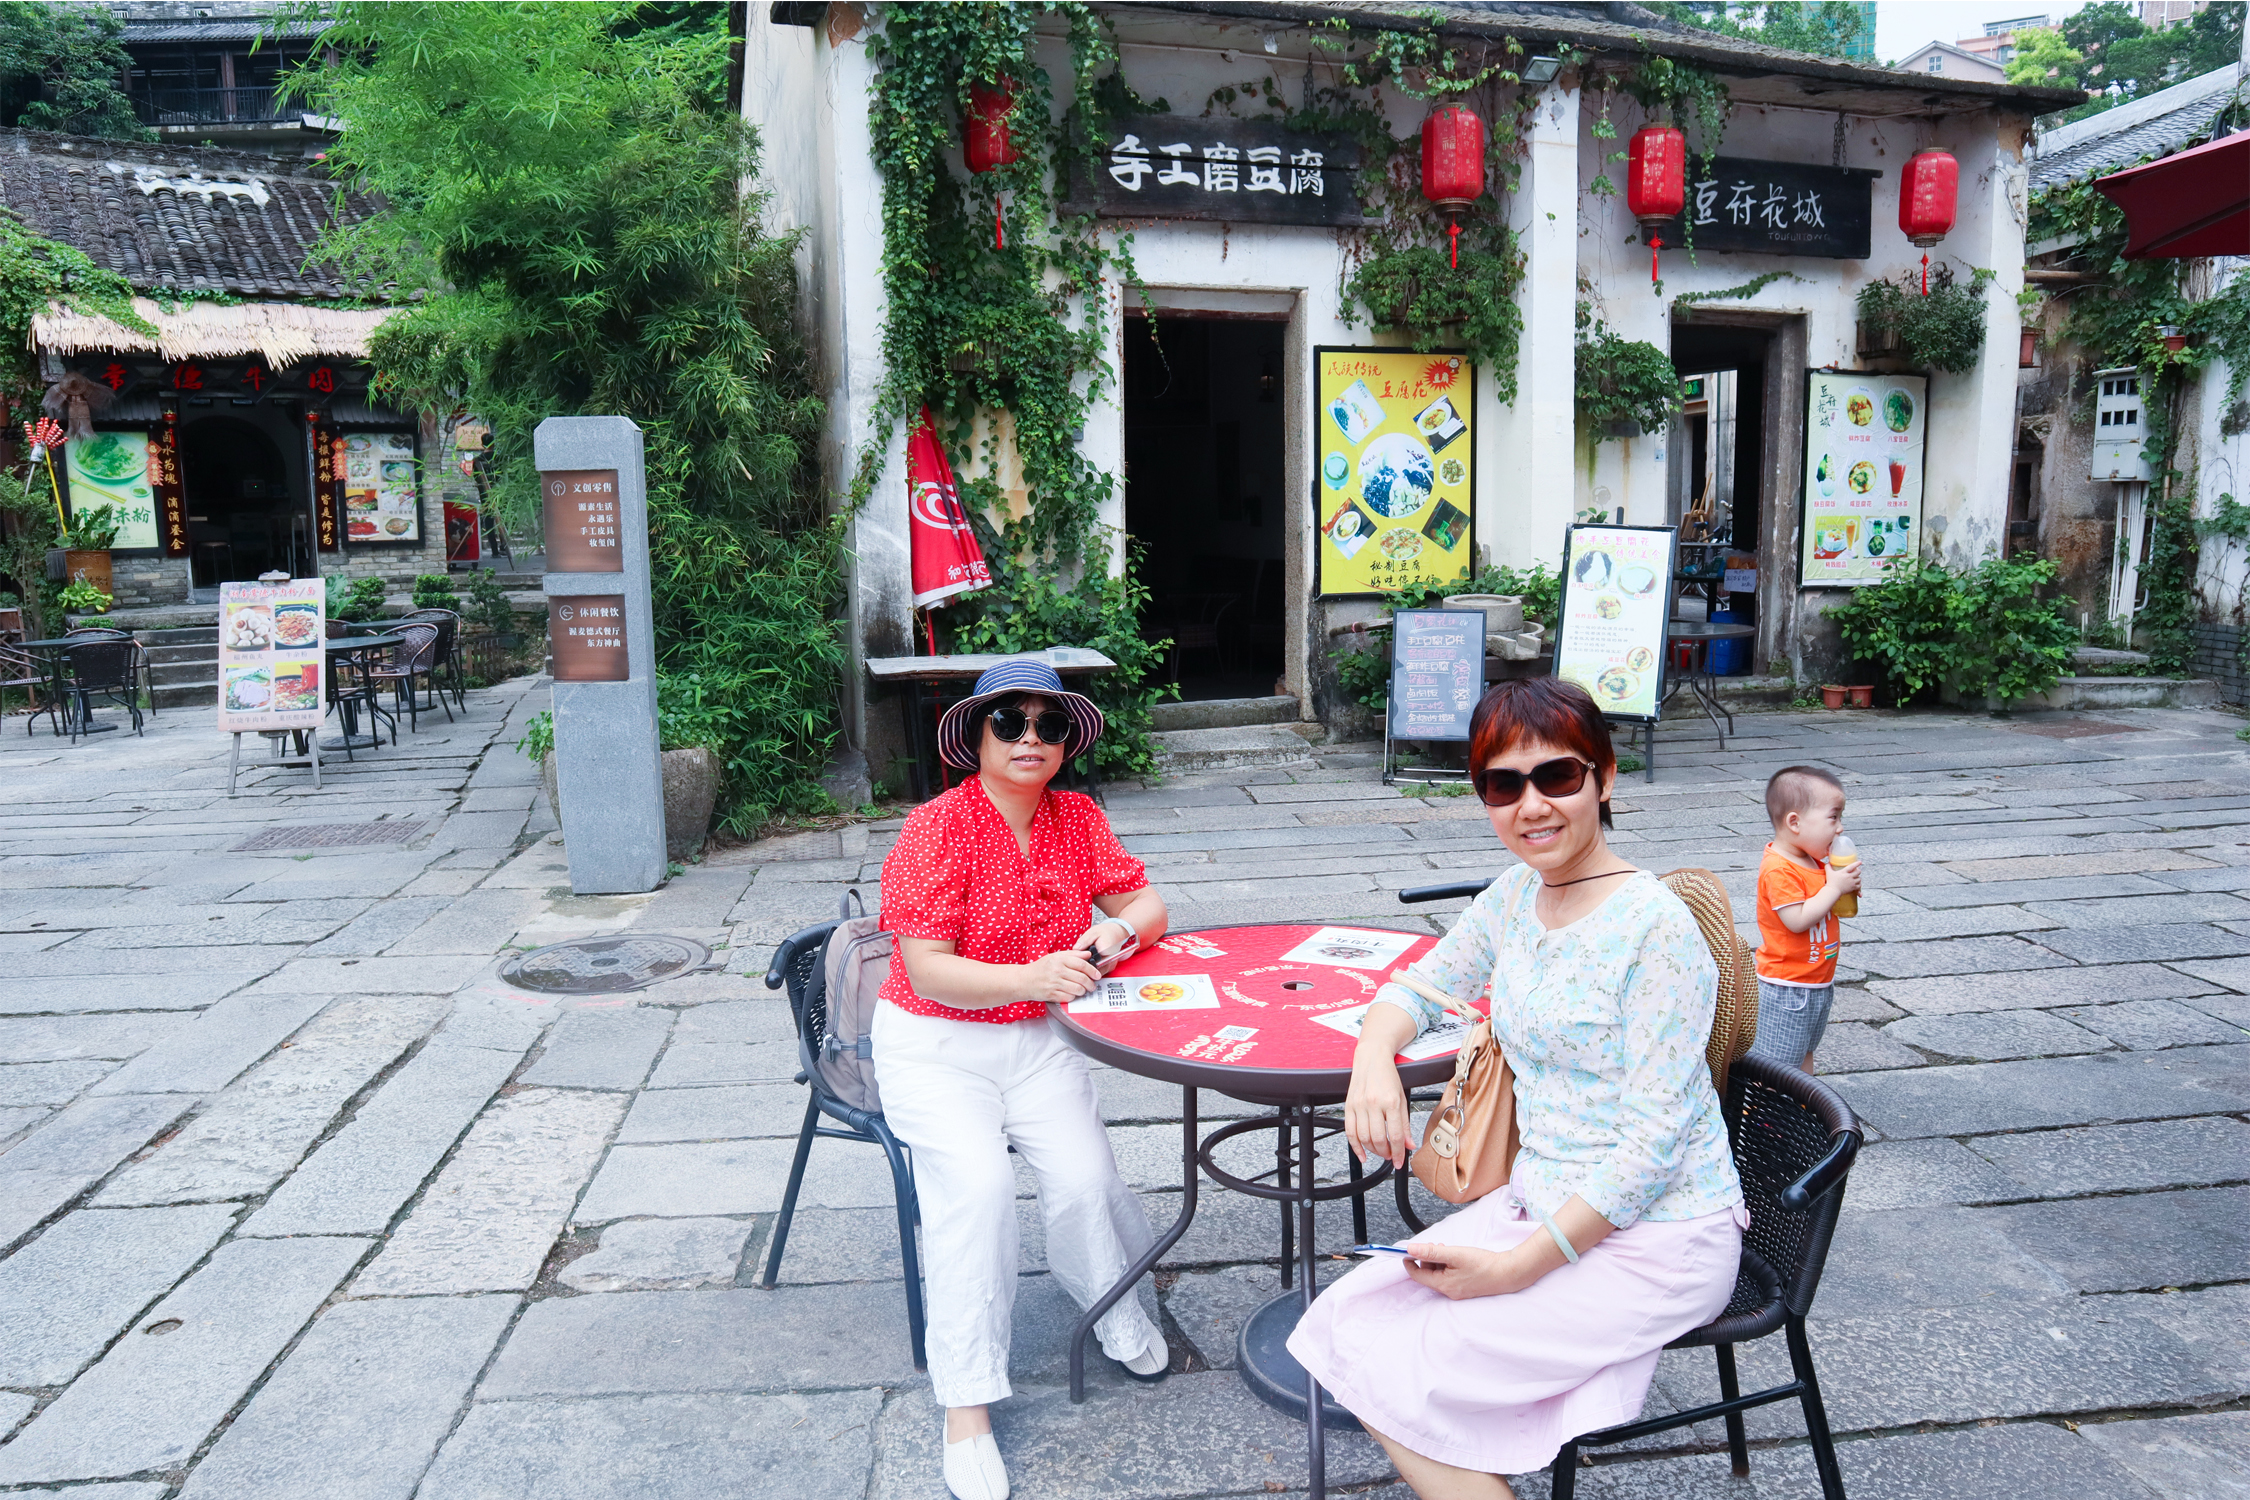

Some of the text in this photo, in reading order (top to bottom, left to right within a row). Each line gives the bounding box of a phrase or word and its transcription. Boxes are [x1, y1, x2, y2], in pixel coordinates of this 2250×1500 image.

[1109, 134, 1325, 196] 手工磨豆腐
[1694, 180, 1826, 229] 豆府花城
[1328, 361, 1382, 377] 民族传统
[101, 362, 334, 393] 常德牛肉
[1379, 380, 1428, 400] 豆腐花
[573, 482, 613, 493] 文创零售
[78, 506, 151, 525] 牛米粉
[580, 526, 615, 535] 手工皮具
[1370, 560, 1420, 572] 秘制豆腐
[580, 607, 619, 617] 休闲餐饮
[587, 638, 621, 648] 东方神曲
